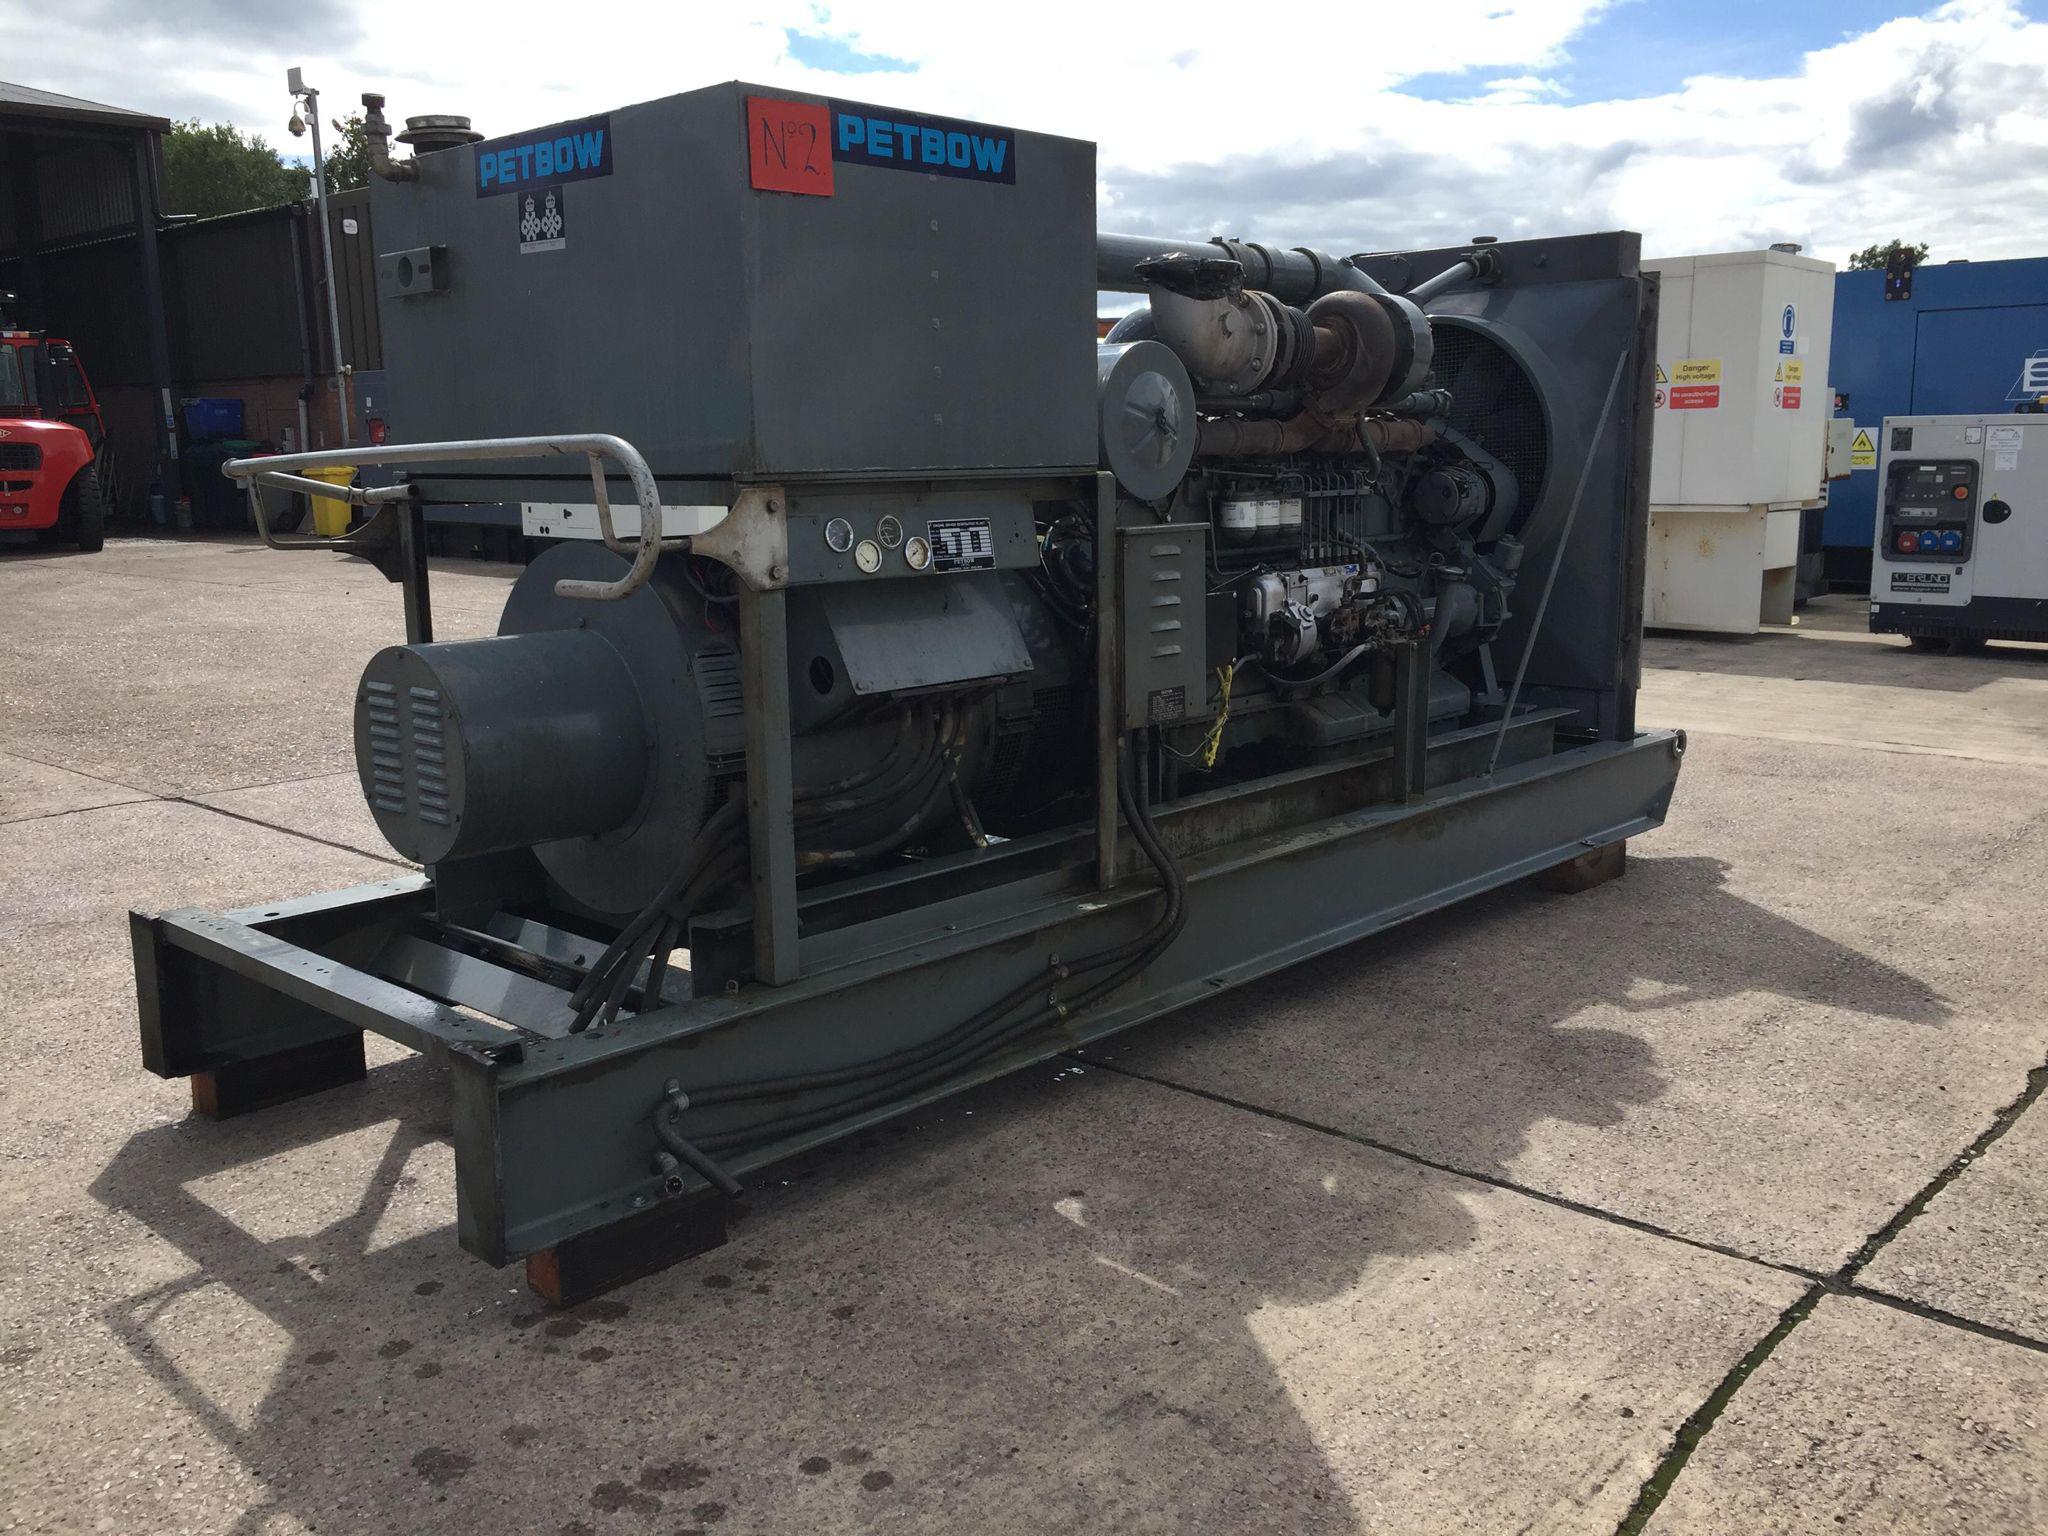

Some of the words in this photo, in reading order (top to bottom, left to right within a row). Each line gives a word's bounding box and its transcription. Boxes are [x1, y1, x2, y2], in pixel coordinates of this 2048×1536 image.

[480, 129, 604, 188] PETBOW
[836, 113, 1008, 175] PETBOW
[1682, 364, 1711, 373] Danger
